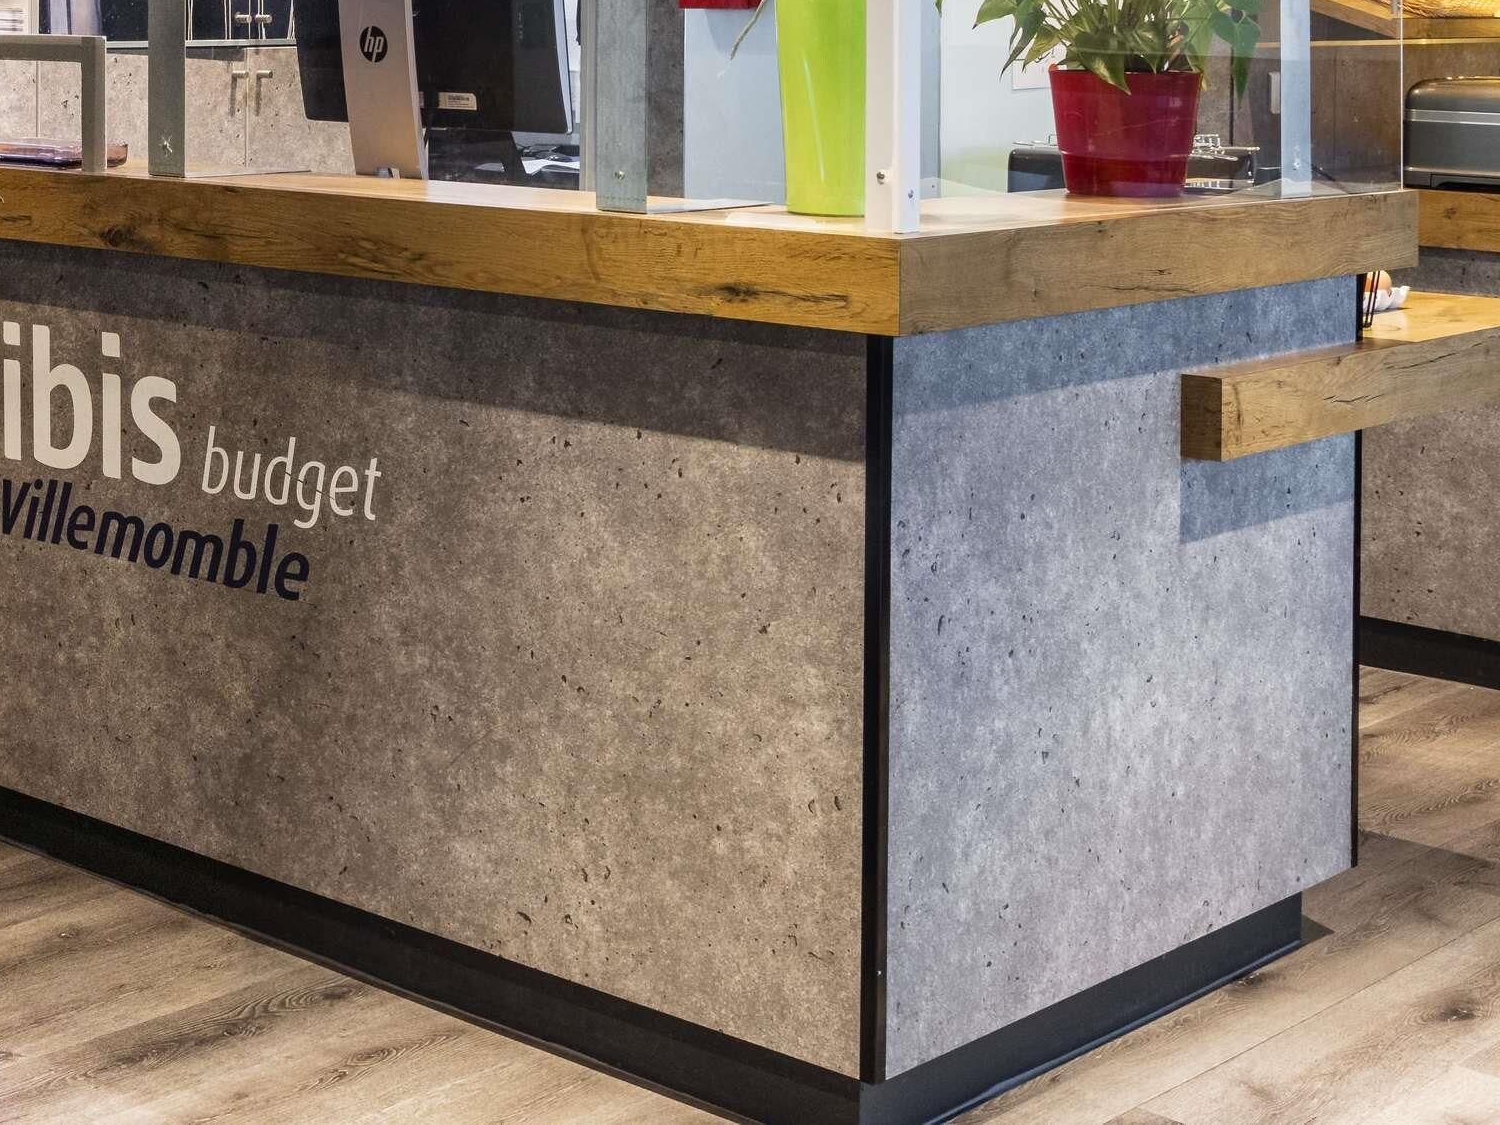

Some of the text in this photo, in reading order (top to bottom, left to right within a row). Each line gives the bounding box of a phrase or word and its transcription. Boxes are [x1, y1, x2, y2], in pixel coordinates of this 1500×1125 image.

[363, 26, 385, 63] hp
[2, 320, 382, 529] ibis budget
[1, 478, 311, 602] Villemomble
